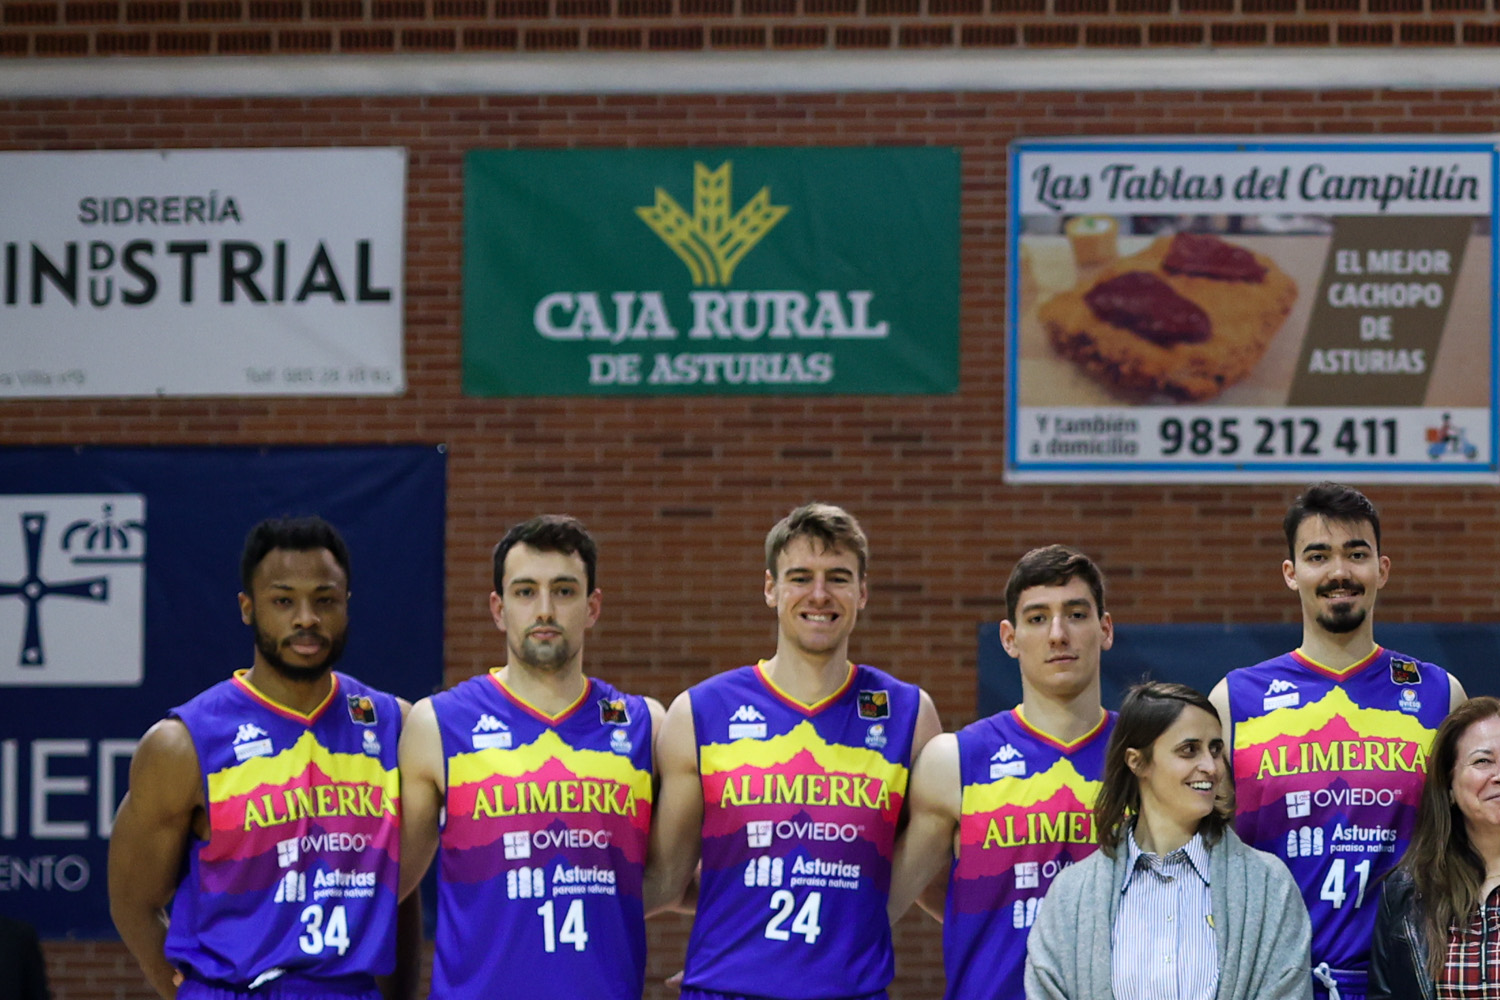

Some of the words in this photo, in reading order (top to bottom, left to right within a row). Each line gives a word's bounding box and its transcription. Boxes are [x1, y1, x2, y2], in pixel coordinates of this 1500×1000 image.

[1033, 164, 1091, 211] Las
[1101, 163, 1224, 201] Tablas
[1234, 165, 1290, 201] del
[1299, 163, 1480, 211] Campillín
[78, 190, 241, 225] SIDRERÍA
[1336, 251, 1363, 274] EL
[1367, 250, 1451, 274] MEJOR
[1328, 284, 1443, 308] CACHOPO
[533, 292, 677, 343] CAJA
[689, 291, 889, 339] RURAL
[1360, 317, 1393, 341] DE
[588, 353, 641, 383] DE
[648, 353, 834, 384] ASTURIAS
[1309, 349, 1425, 374] ASTURIAS
[1047, 438, 1139, 456] domicilio
[1159, 417, 1241, 456] 985
[1254, 417, 1321, 456] 212
[1333, 417, 1399, 456] 411
[1256, 739, 1428, 780] ALIMERKA
[471, 780, 638, 821] ALIMERKA
[719, 773, 892, 811] ALIMERKA
[1331, 823, 1397, 842] Asturias
[552, 863, 617, 885] Asturias
[790, 855, 861, 879] Asturias
[1319, 857, 1371, 909] 41
[298, 903, 351, 957] 34
[536, 899, 589, 953] 14
[764, 889, 822, 945] 24
